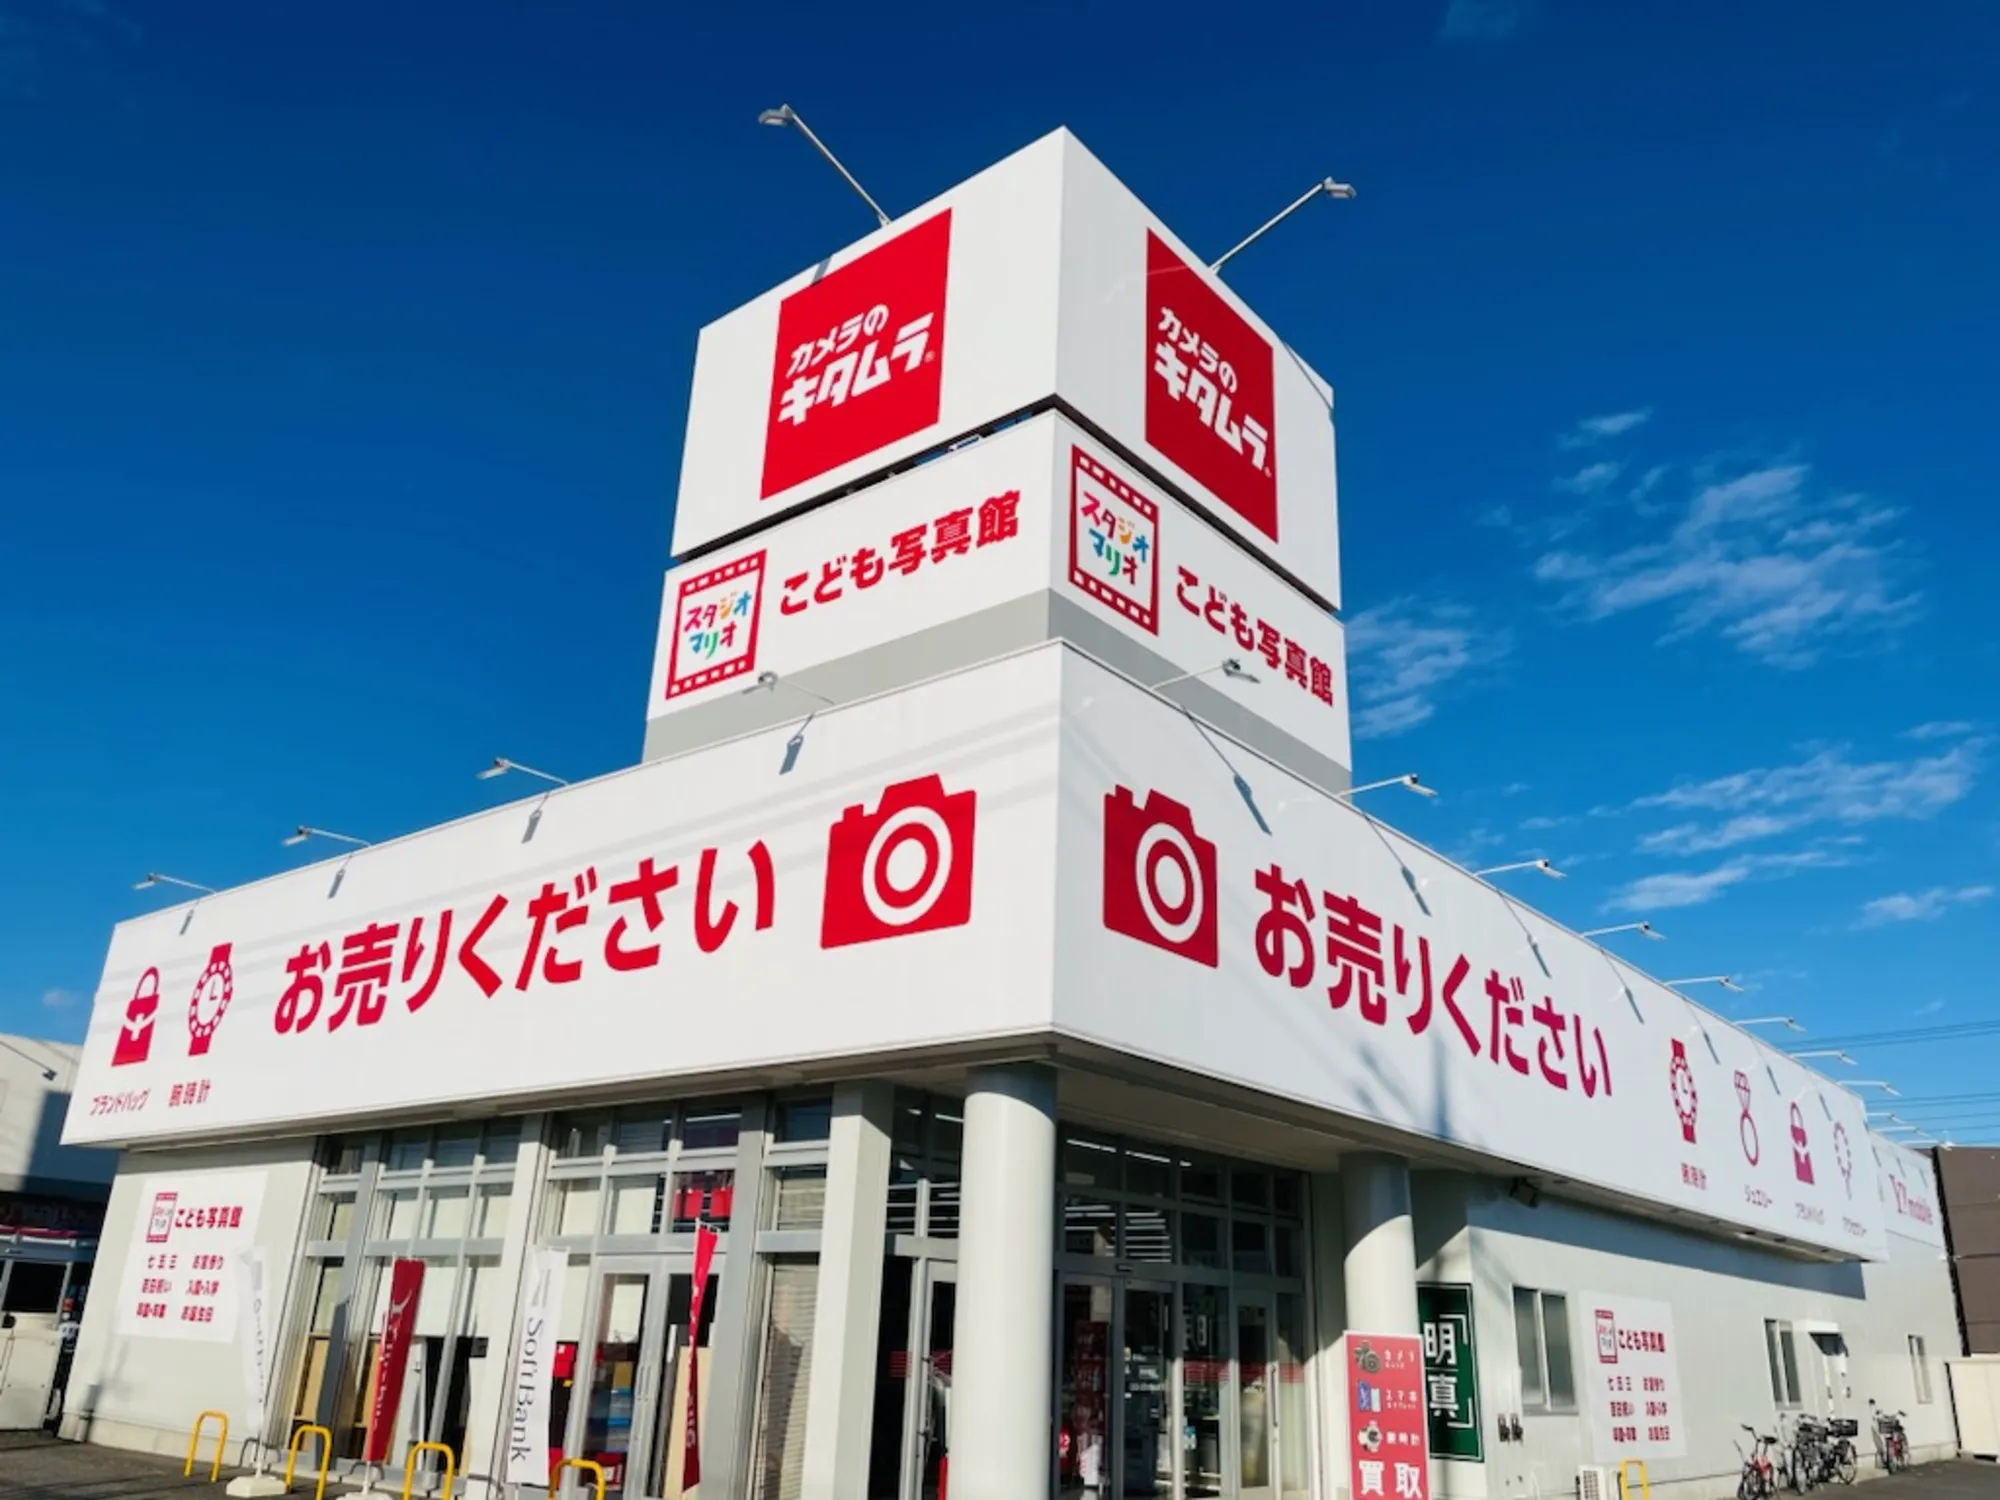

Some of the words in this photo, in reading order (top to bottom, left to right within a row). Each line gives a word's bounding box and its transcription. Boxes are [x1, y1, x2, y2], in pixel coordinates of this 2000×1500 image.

[785, 304, 890, 379] カメラの
[1158, 306, 1238, 393] カメラの
[779, 489, 1021, 616] こども写真館
[1081, 491, 1149, 564] スタジオ
[1089, 528, 1137, 585] マリオ
[684, 590, 752, 633] スタジオ
[689, 621, 737, 660] マリオ
[1175, 566, 1333, 707] こども写真館
[274, 840, 776, 1034] お売りください
[1255, 863, 1612, 1098] お売りください
[175, 1206, 243, 1229] こども写真館
[510, 1316, 543, 1463] SoftBank
[1359, 1460, 1423, 1499] 買取
